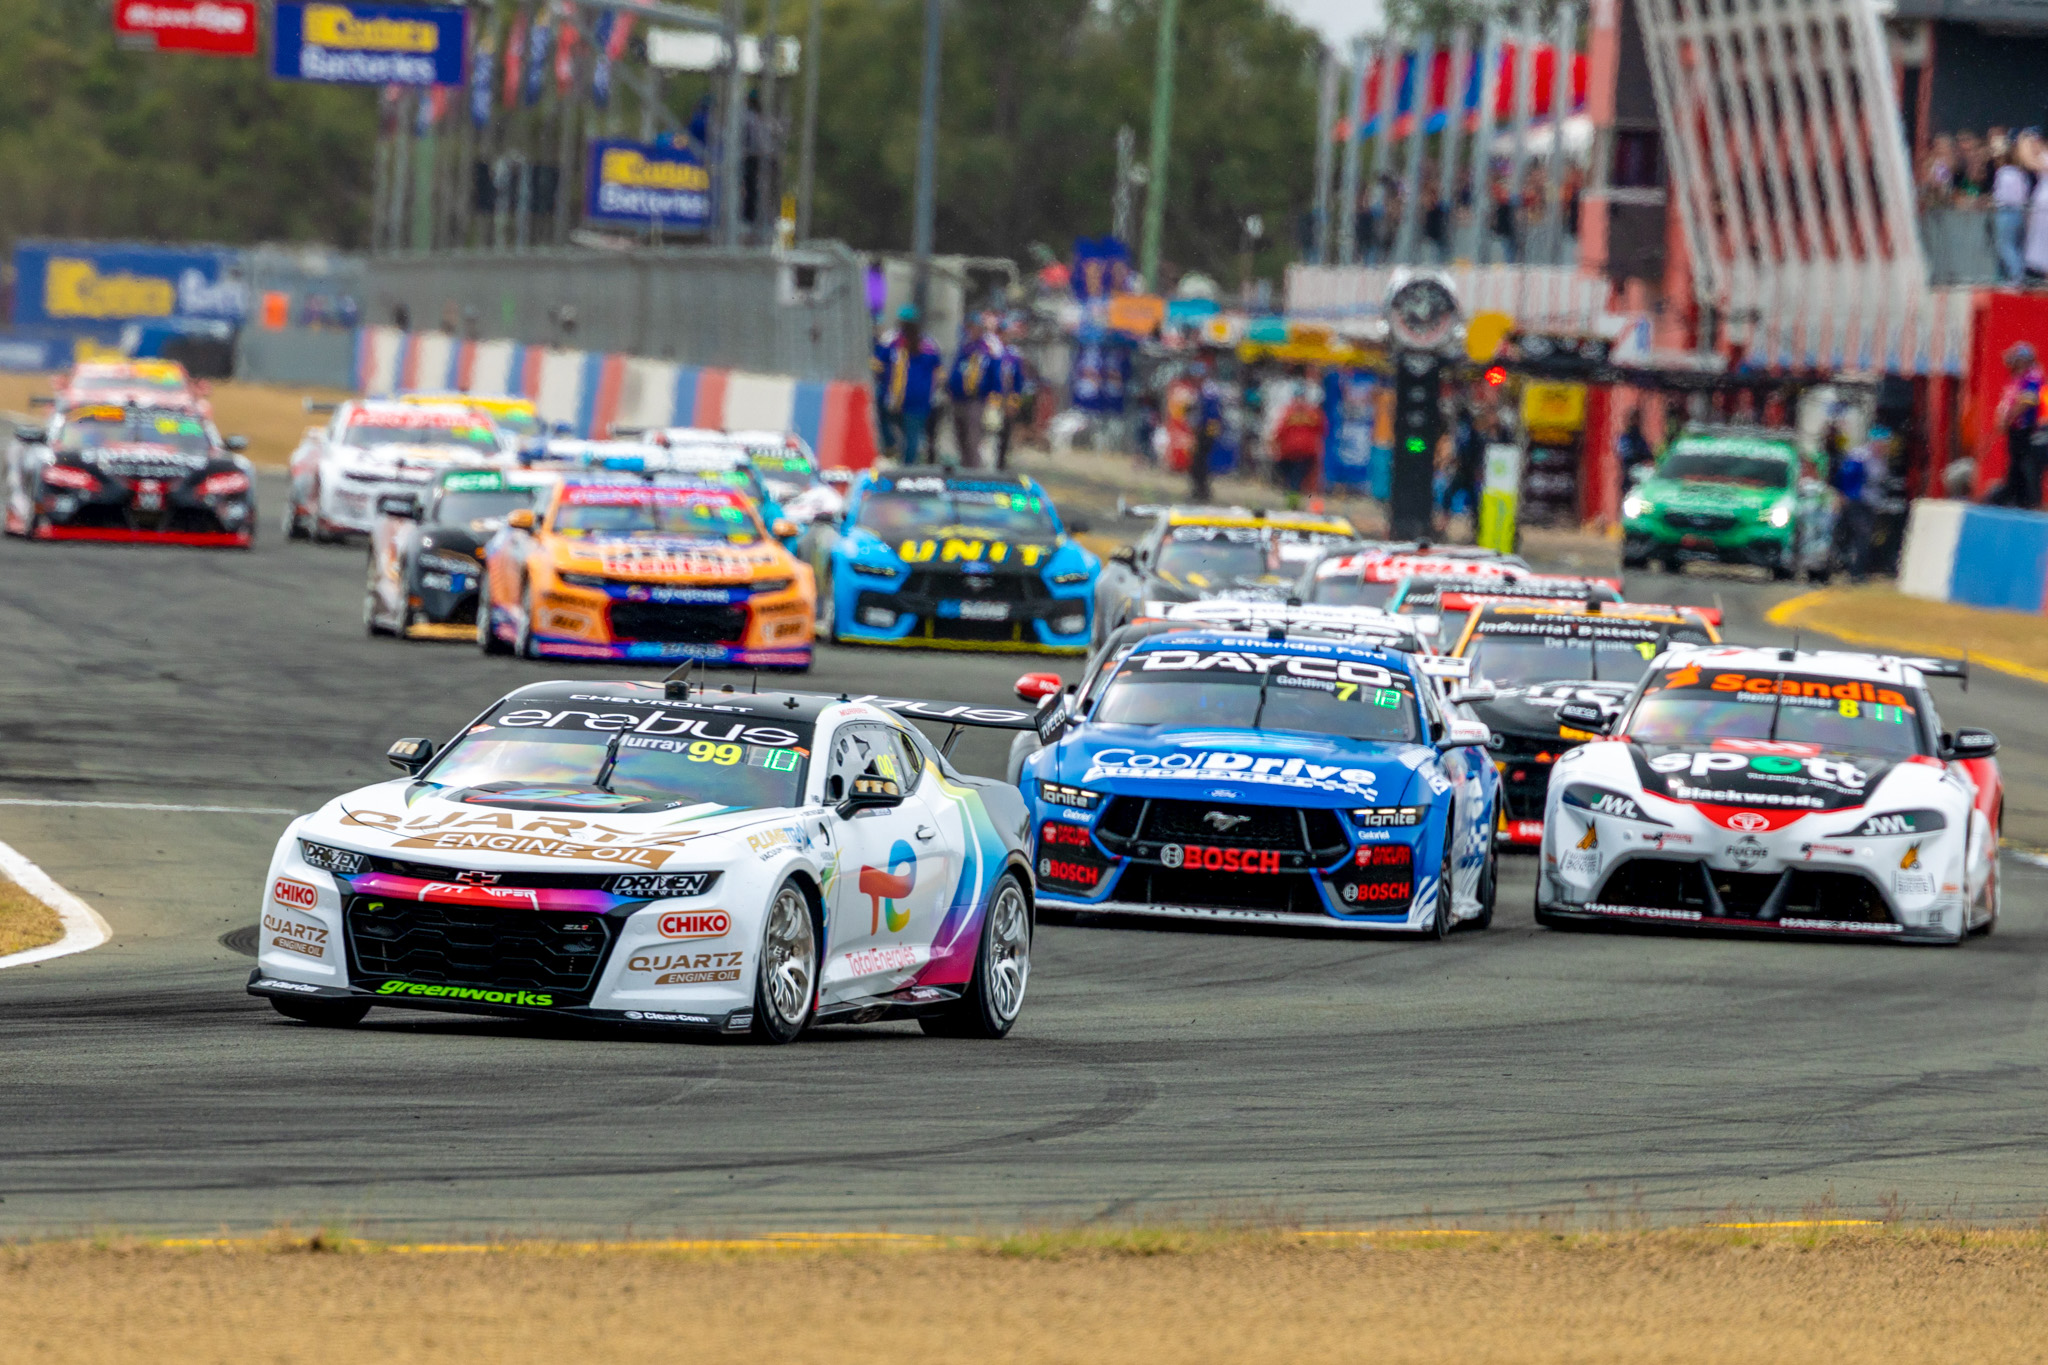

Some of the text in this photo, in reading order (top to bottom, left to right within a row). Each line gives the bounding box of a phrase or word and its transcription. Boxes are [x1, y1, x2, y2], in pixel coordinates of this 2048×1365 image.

[899, 538, 1049, 567] UNIT
[1477, 621, 1571, 636] Industrial
[1336, 645, 1388, 661] Ford
[1142, 650, 1393, 688] DAYCO
[1277, 675, 1358, 701] Golding 7
[1373, 688, 1402, 710] 12
[1710, 673, 1908, 707] Scandia
[569, 694, 754, 713] CHEVROLET
[1837, 698, 1860, 718] 8
[498, 708, 800, 747] erebus
[606, 734, 743, 766] Murray 99
[762, 748, 801, 772] 10
[1092, 748, 1377, 785] CoolDrive
[1043, 789, 1088, 808] ignite
[1676, 786, 1826, 809] Blackwoods
[1063, 808, 1094, 823] Gabriel
[1365, 814, 1417, 827] ignite
[339, 809, 701, 849] QUARTZ
[306, 842, 363, 869] DRIVEN
[432, 833, 652, 864] ENGINE OIL
[1183, 845, 1281, 875] BOSCH
[614, 875, 704, 890] DRIVEN
[1050, 859, 1099, 886] BOSCH
[274, 881, 314, 906] CHIKO
[480, 886, 540, 912] VIPER
[1358, 882, 1411, 901] BOSCH
[263, 914, 329, 945] QUARTZ
[662, 915, 728, 934] CHIKO
[279, 938, 322, 957] ENGINE OIL
[845, 941, 917, 977] TotalEnergies
[628, 951, 744, 973] QUARTZ
[668, 971, 738, 984] ENGINE OIL
[375, 979, 554, 1007] greenworks
[643, 1011, 710, 1023] Clear-Com
